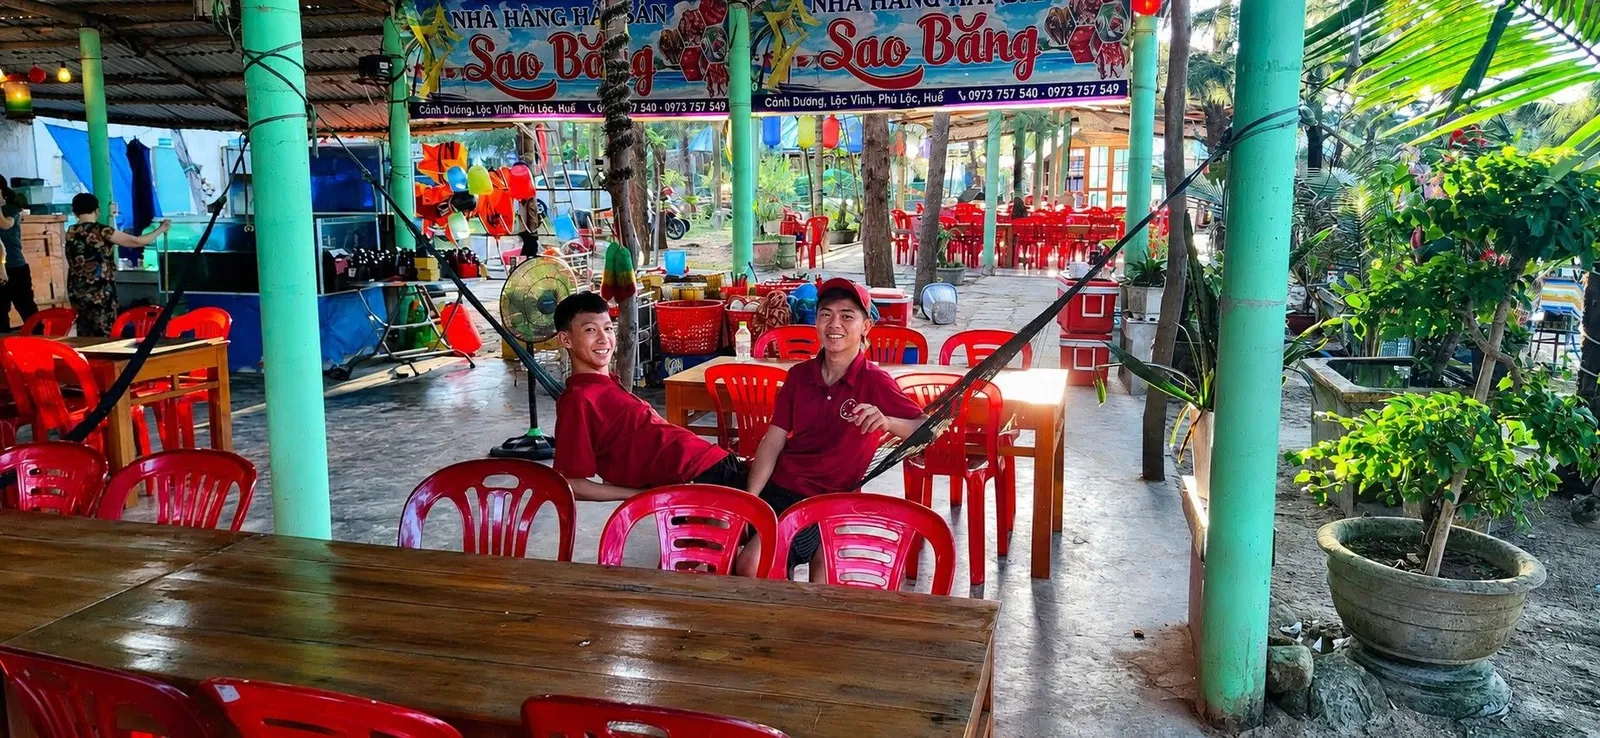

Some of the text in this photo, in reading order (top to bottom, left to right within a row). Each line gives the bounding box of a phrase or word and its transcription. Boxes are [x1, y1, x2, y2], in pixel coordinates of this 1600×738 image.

[451, 4, 498, 29] NHÀ
[503, 3, 567, 27] HÀNG
[572, 0, 605, 26] HẢ
[817, 12, 1042, 90] Sao Băng
[463, 31, 657, 100] Sao Băg
[968, 87, 1039, 100] 0973 757 540
[1047, 83, 1120, 97] 0973 757 549
[664, 101, 726, 112] 0973 757 549
[830, 94, 847, 108] Lộc
[900, 92, 921, 106] Lộc,
[923, 89, 945, 103] Huế
[640, 102, 657, 112] 540
